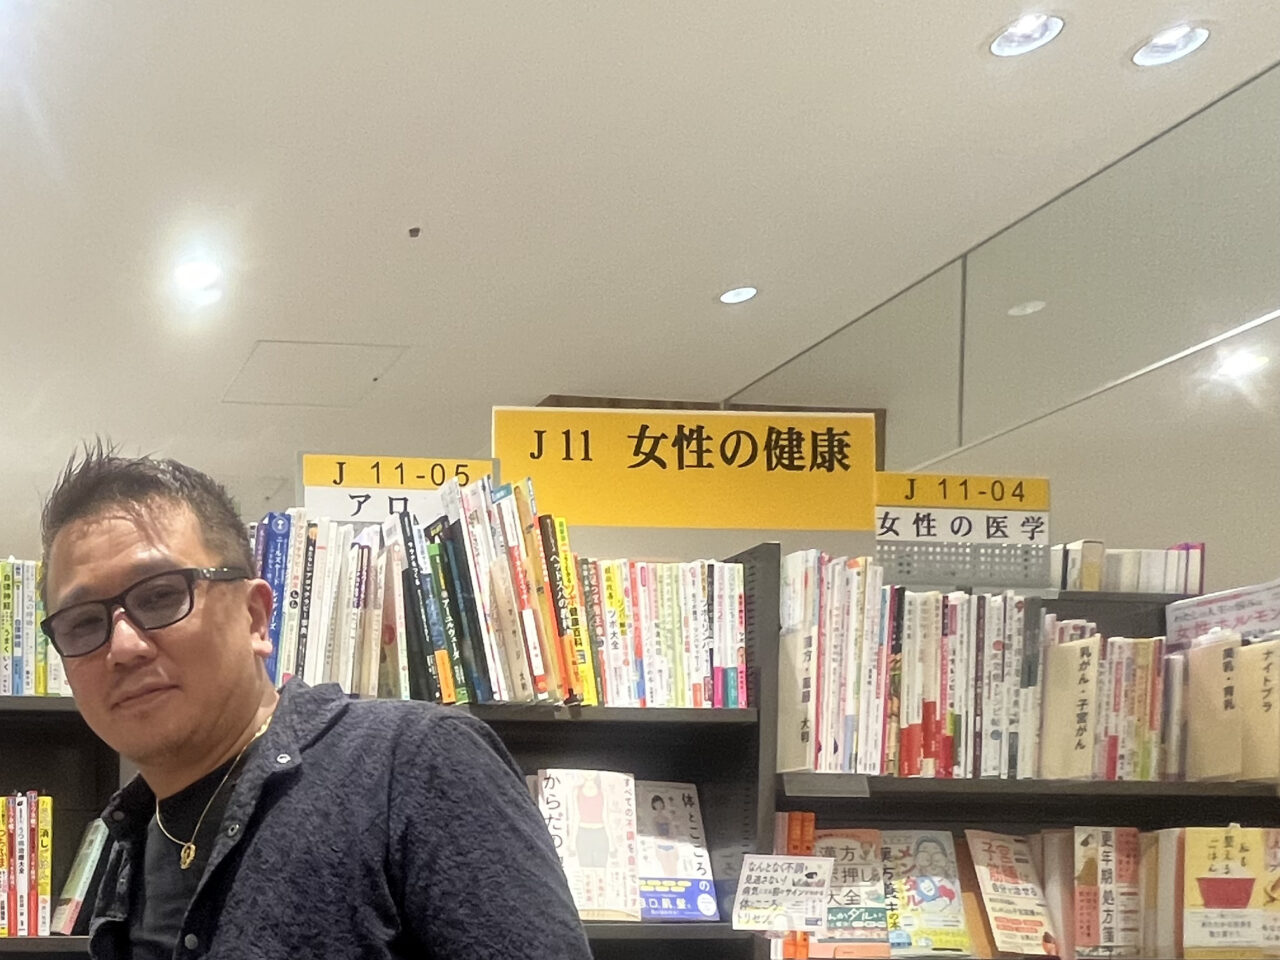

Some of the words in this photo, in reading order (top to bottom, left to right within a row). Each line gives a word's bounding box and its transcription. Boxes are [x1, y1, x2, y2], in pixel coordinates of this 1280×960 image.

[529, 430, 547, 460] J
[561, 429, 594, 461] 11
[627, 424, 852, 472] 女性の健康
[332, 461, 346, 486] J
[370, 461, 470, 487] 11-05
[904, 478, 917, 500] J
[938, 478, 1026, 503] 11-04
[877, 511, 1046, 541] 女性の医学
